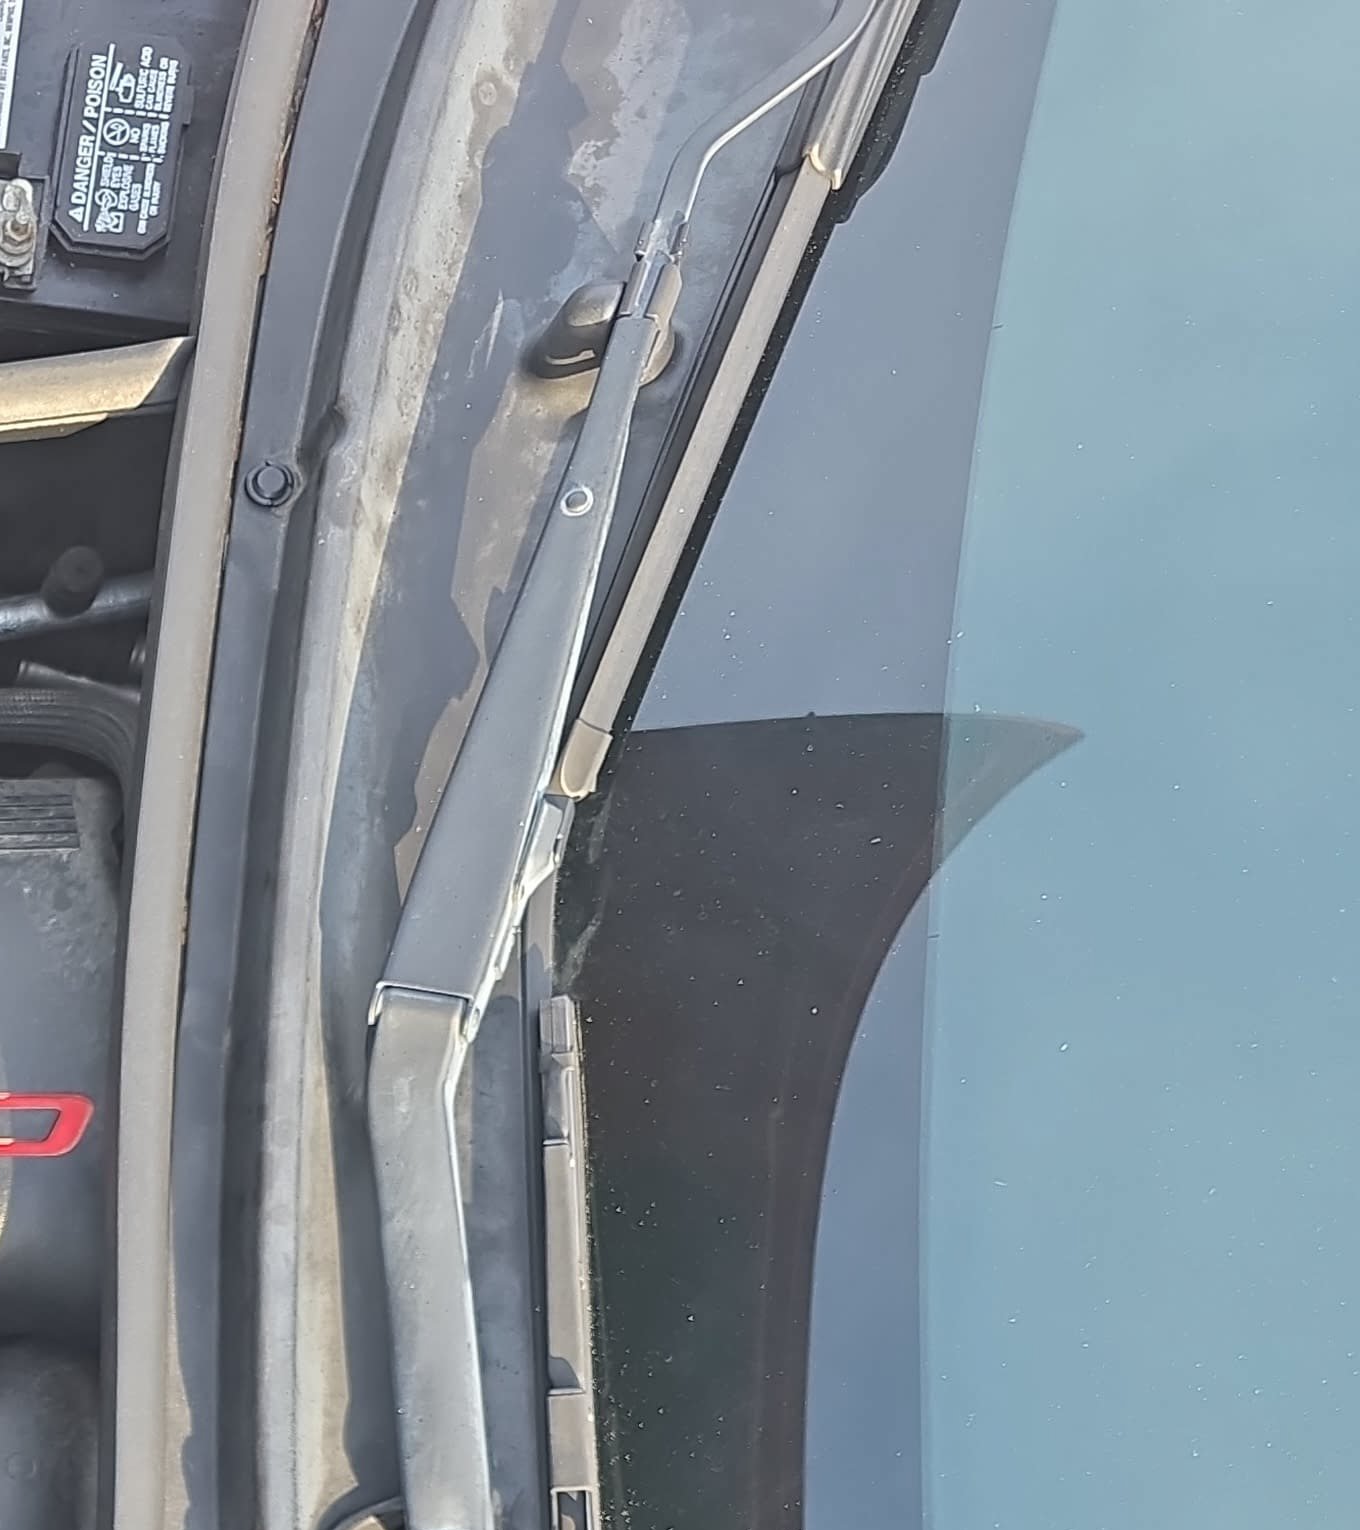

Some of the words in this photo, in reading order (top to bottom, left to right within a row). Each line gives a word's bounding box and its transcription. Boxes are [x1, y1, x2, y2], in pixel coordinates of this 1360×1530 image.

[71, 134, 95, 206] DANGER
[83, 54, 107, 119] POISON
[129, 127, 141, 144] NO
